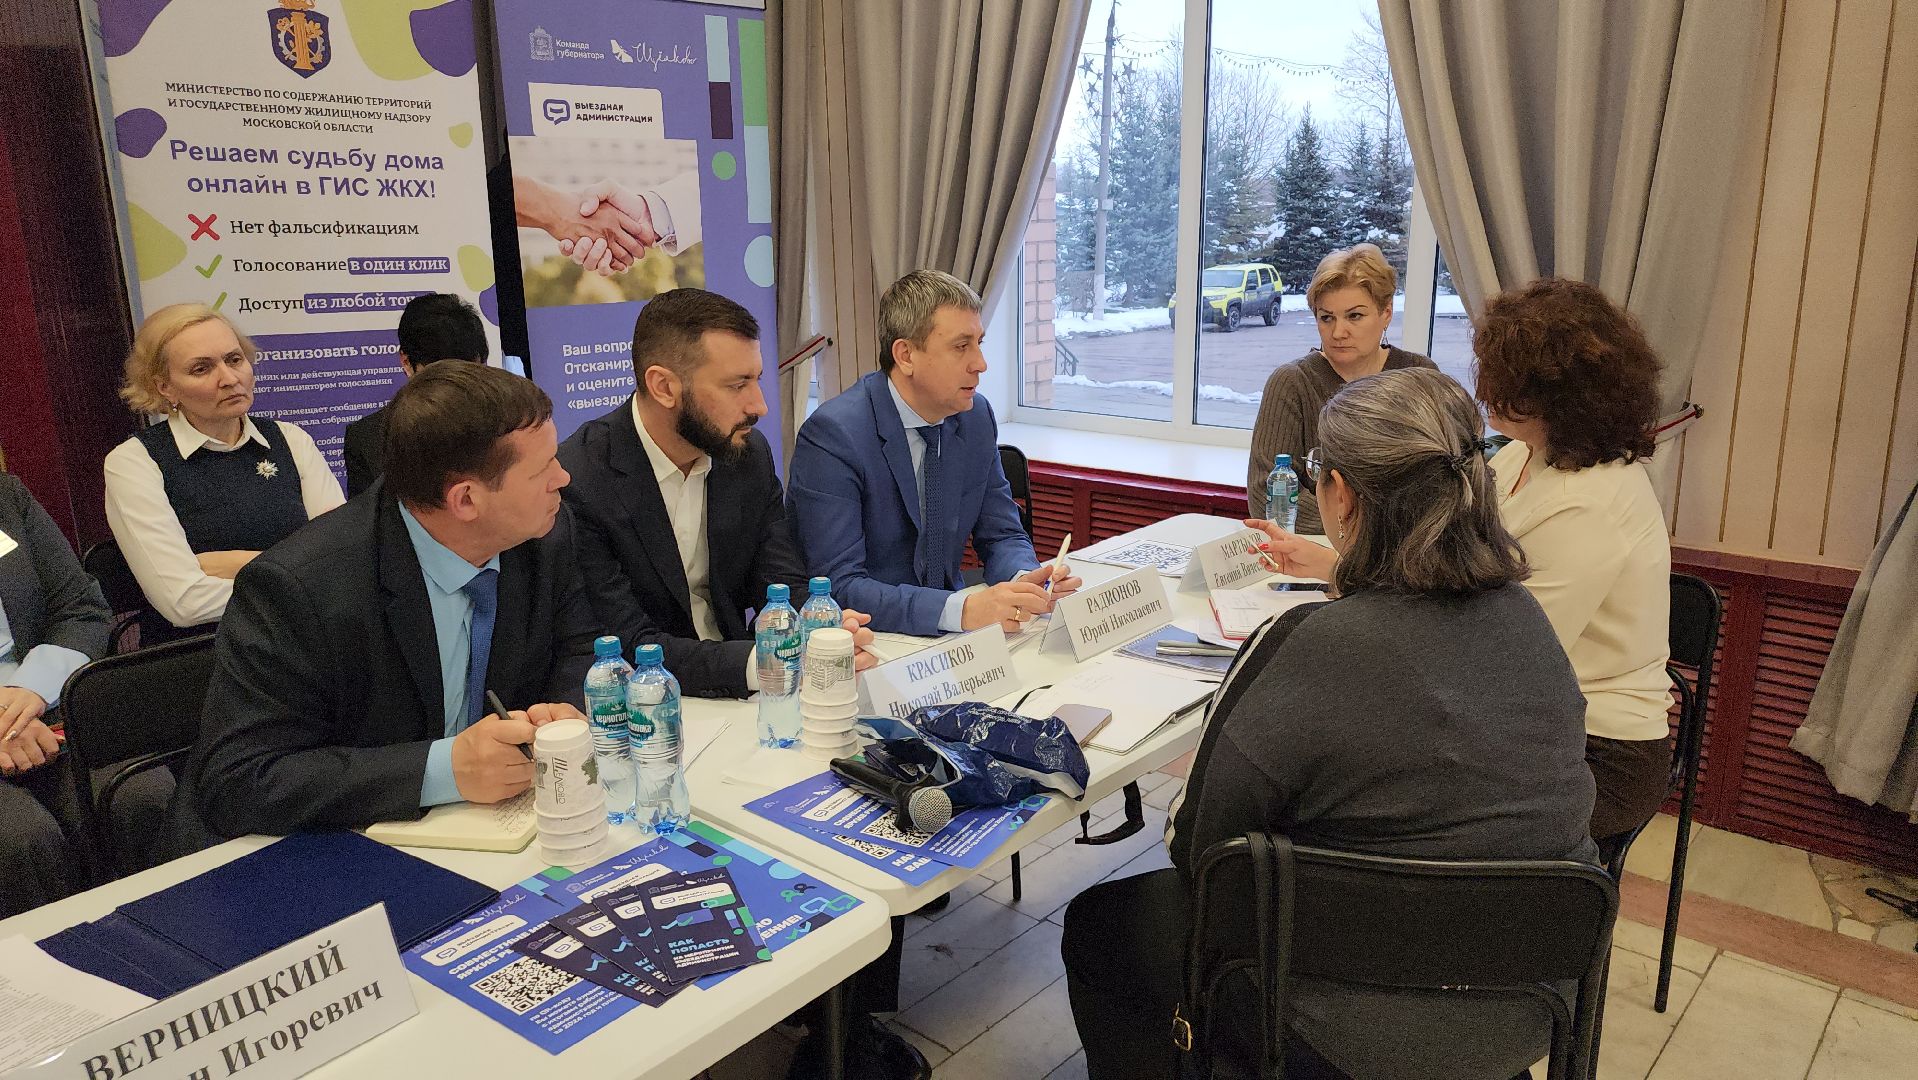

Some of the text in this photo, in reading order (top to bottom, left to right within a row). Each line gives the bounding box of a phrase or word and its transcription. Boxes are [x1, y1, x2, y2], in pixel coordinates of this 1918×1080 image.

[555, 39, 590, 50] Команда
[556, 49, 605, 60] губернатора
[165, 82, 432, 109] МИНИСТЕРСТВО ПО СОДЕРЖАНИЮ ТЕРРИТОРИЙ
[168, 98, 431, 123] И ГОСУДАРСТВЕННОМУ ЖИЛИЩНОМУ НАДЗОРУ
[575, 102, 624, 112] ВЫЕЗДНАЯ
[243, 118, 374, 134] МОСКОВСКОЙ ОБЛАСТИ
[576, 113, 653, 124] АДМИНИСТРАЦИЯ
[170, 139, 444, 172] Решаем судьбу дома
[187, 174, 436, 198] онлайн в ГИС ЖКХ!
[230, 219, 419, 238] Нет фальсификациям
[233, 259, 448, 274] Голосование в один клик
[238, 292, 416, 314] Доступ из любой точ
[254, 344, 400, 365] рганизовать голо
[562, 340, 635, 357] Ваш вопро
[254, 366, 405, 382] нник или действующая управля
[564, 359, 635, 375] Отсканиру
[273, 381, 337, 392] инициатором
[338, 378, 393, 388] голосования
[566, 376, 635, 393] и оцените
[567, 393, 632, 410] «выездн
[248, 409, 276, 419] атор
[277, 406, 328, 419] размещает
[329, 402, 380, 412] сообщение
[321, 414, 363, 425] собрания
[316, 436, 345, 446] сообщ
[1214, 565, 1243, 588] Евгений
[1086, 579, 1142, 614] РАДИОНОВ
[1079, 599, 1162, 644] Юрий Николаевич
[905, 643, 975, 683] КРАСИКОВ
[888, 686, 943, 719] Николай
[942, 665, 1006, 700] Валерьевич
[667, 937, 695, 949] КАК
[670, 938, 730, 955] ПОПАСТЬ
[457, 956, 500, 980] ЯРКИЕ
[80, 939, 348, 1080] ВЕРНИЦКИЙ
[218, 980, 385, 1077] Игоревич
